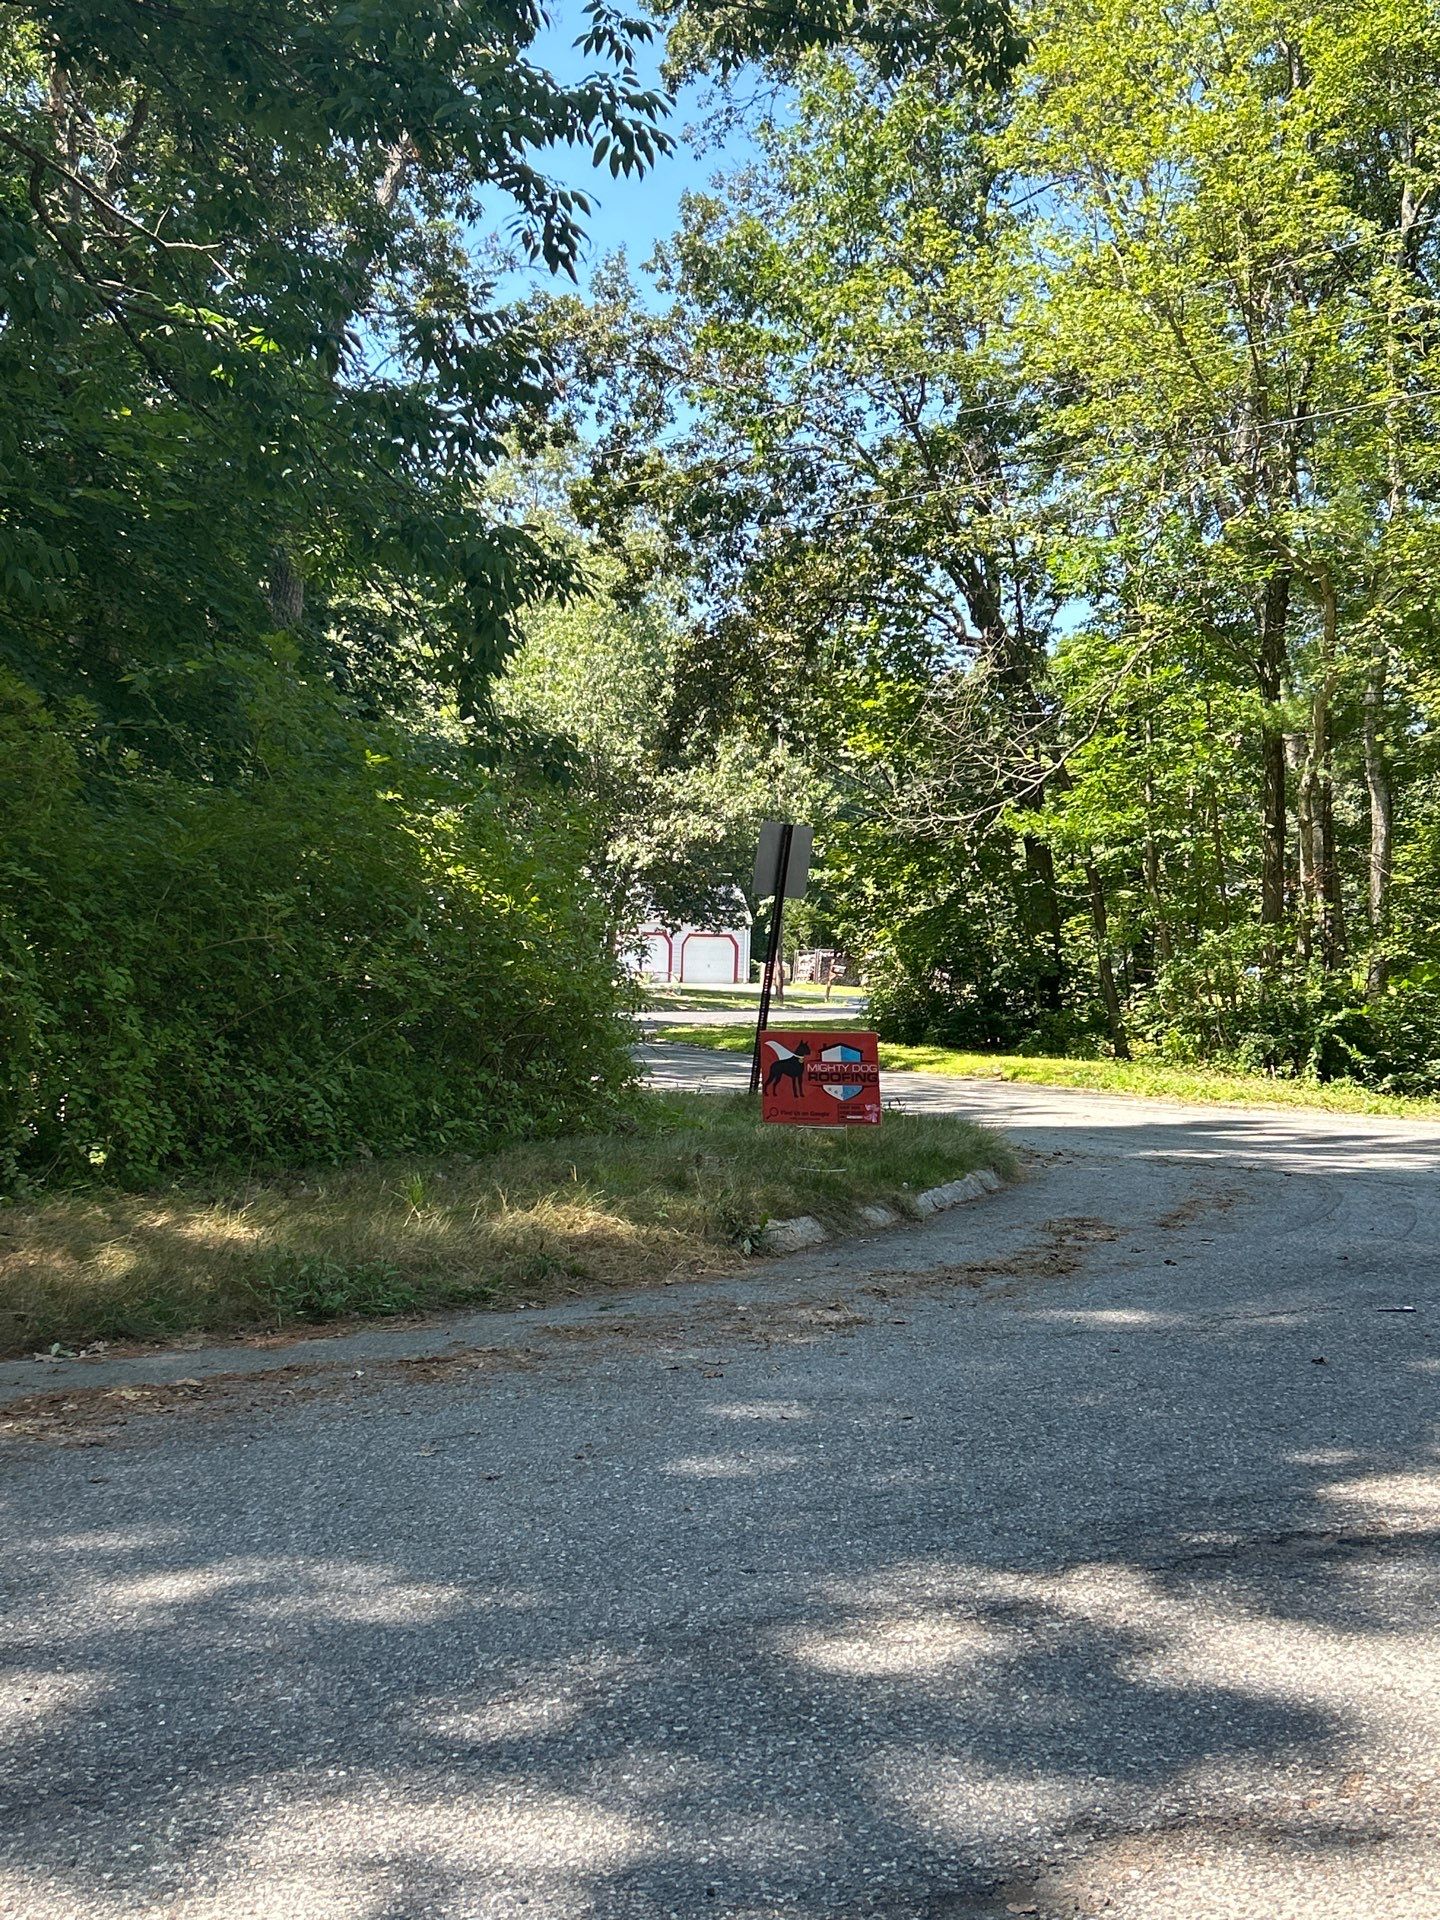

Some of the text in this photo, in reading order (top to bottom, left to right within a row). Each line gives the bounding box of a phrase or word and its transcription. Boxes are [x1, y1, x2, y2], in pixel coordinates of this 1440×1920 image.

[807, 1063, 878, 1073] MIGHTY DOG
[808, 1072, 879, 1083] ROOFING
